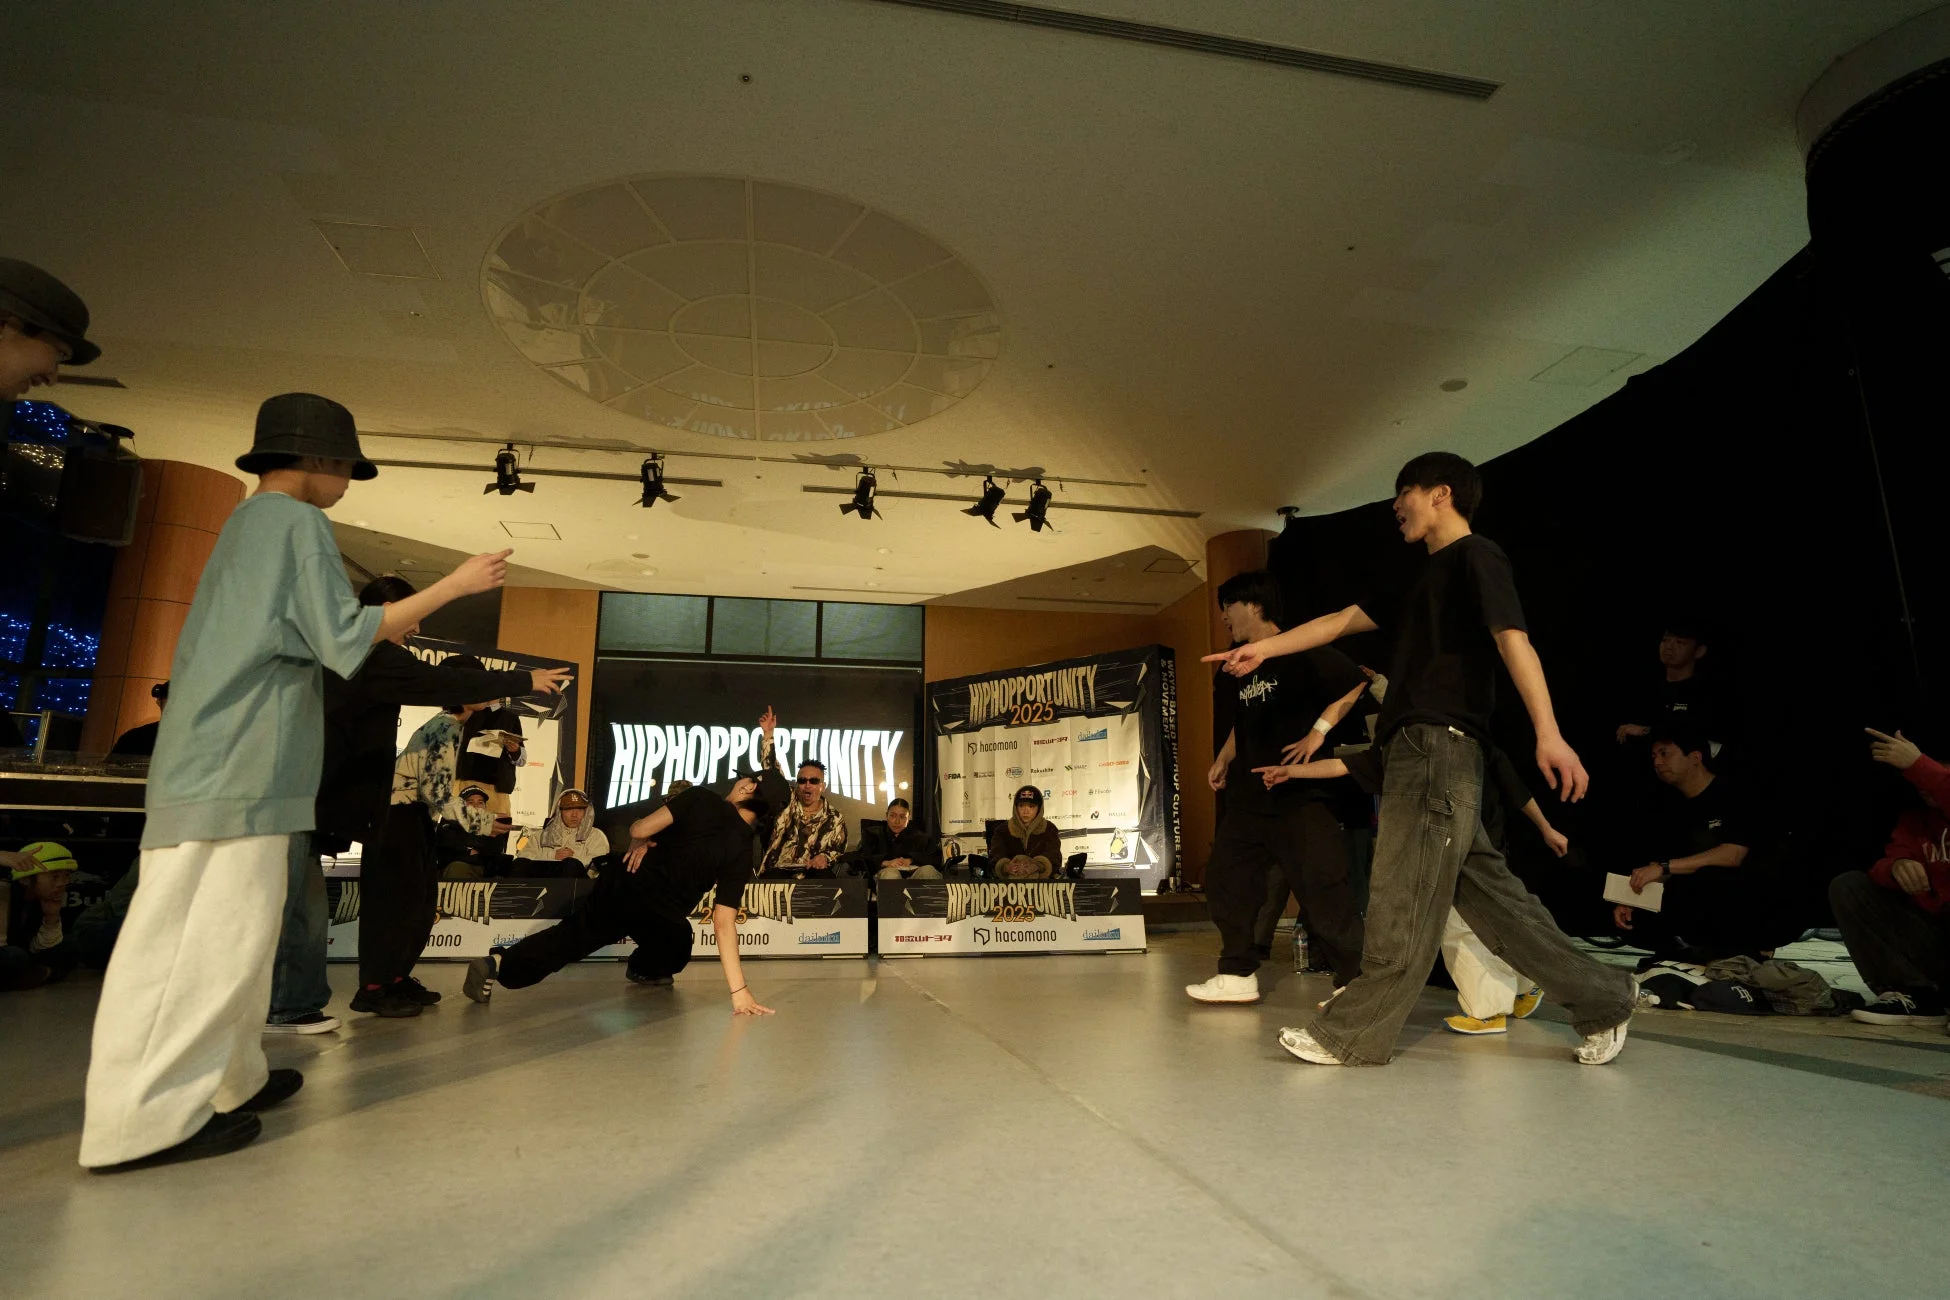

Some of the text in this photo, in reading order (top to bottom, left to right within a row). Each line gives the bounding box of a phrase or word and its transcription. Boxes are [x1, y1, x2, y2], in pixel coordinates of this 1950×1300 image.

[968, 664, 1098, 728] HIPHOPPORTUNITY
[1161, 672, 1170, 740] MOVEMENT
[1010, 701, 1055, 725] 2025
[979, 740, 1018, 753] hacomono
[606, 722, 904, 809] HIPHOPPORTUNITY
[1172, 793, 1182, 851] CULTURE
[946, 882, 1077, 924] HIPHOPPORTUNITY
[991, 905, 1036, 923] 2025
[698, 907, 748, 925] 25
[700, 929, 769, 946] hamono
[995, 927, 1057, 942] hacomono
